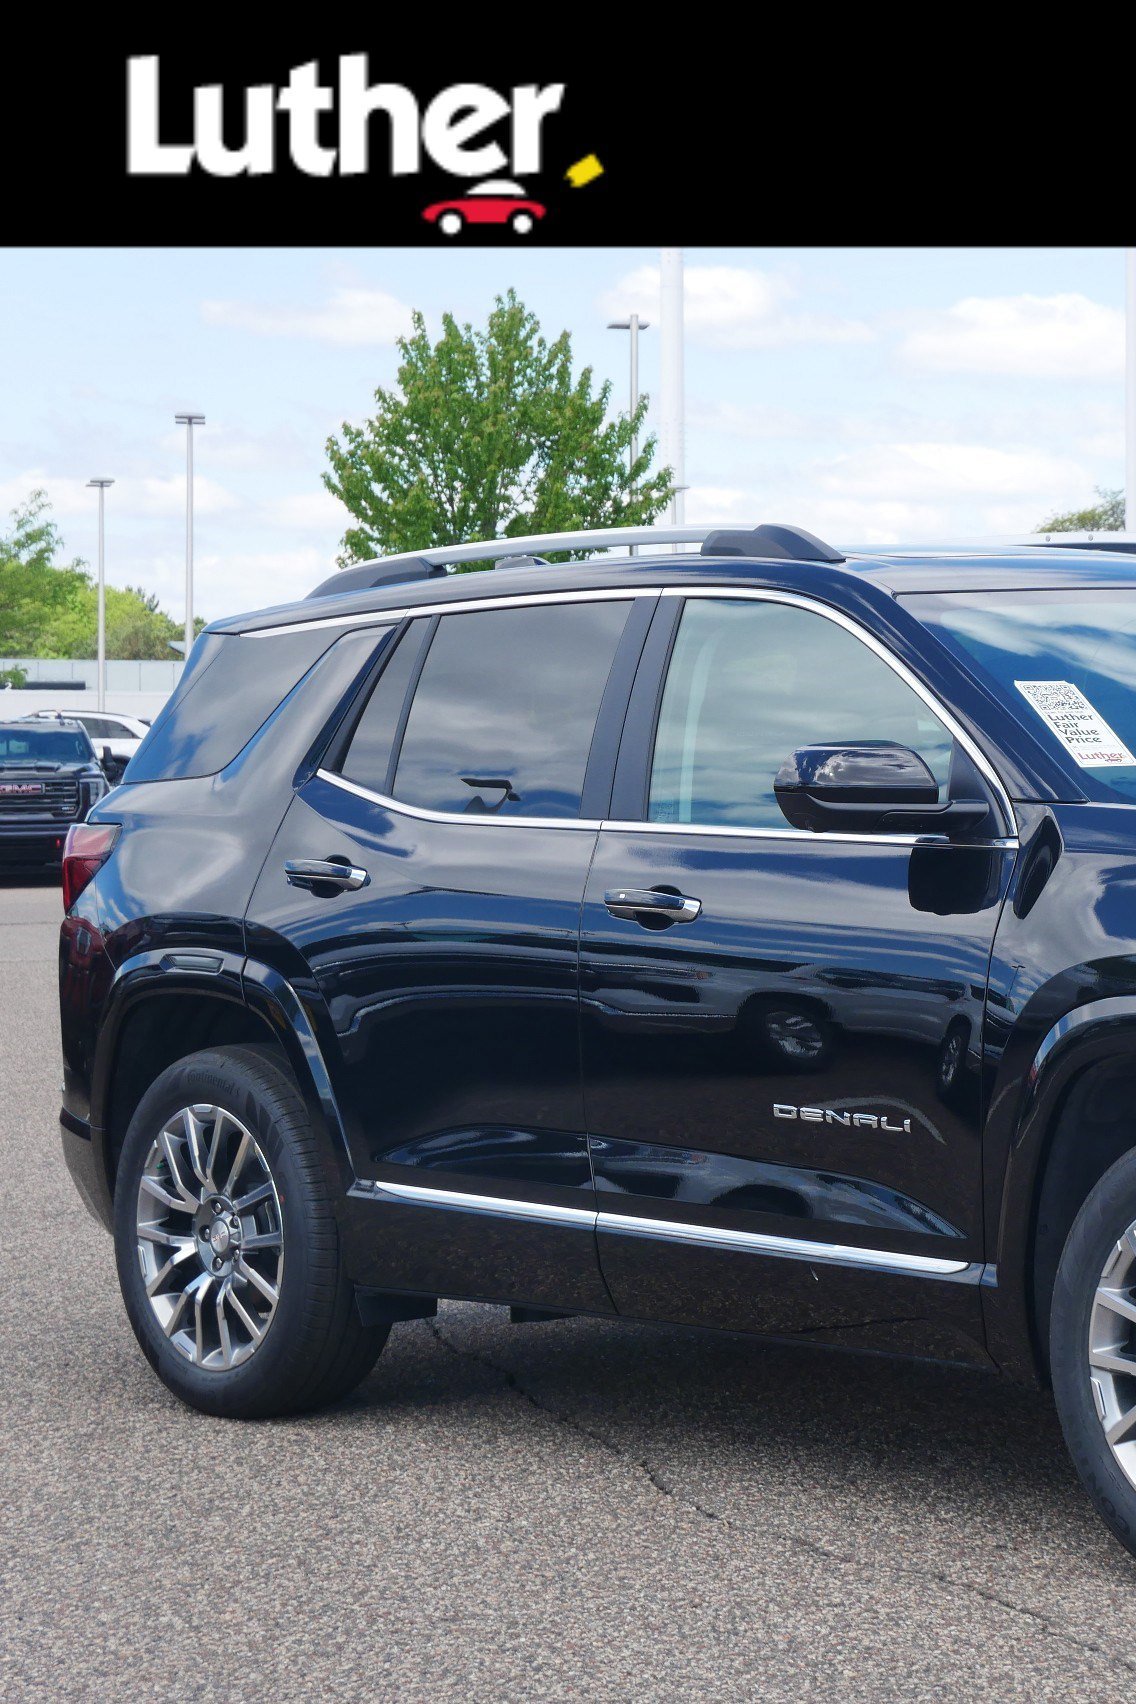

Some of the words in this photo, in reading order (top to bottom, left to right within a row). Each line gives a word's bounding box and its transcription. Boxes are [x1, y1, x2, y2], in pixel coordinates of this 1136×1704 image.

[1047, 713, 1094, 721] Luther
[1053, 721, 1079, 729] Fair
[1058, 728, 1100, 736] Value
[1065, 735, 1103, 744] Price
[1077, 751, 1123, 760] Luther
[772, 1103, 912, 1134] DENALI
